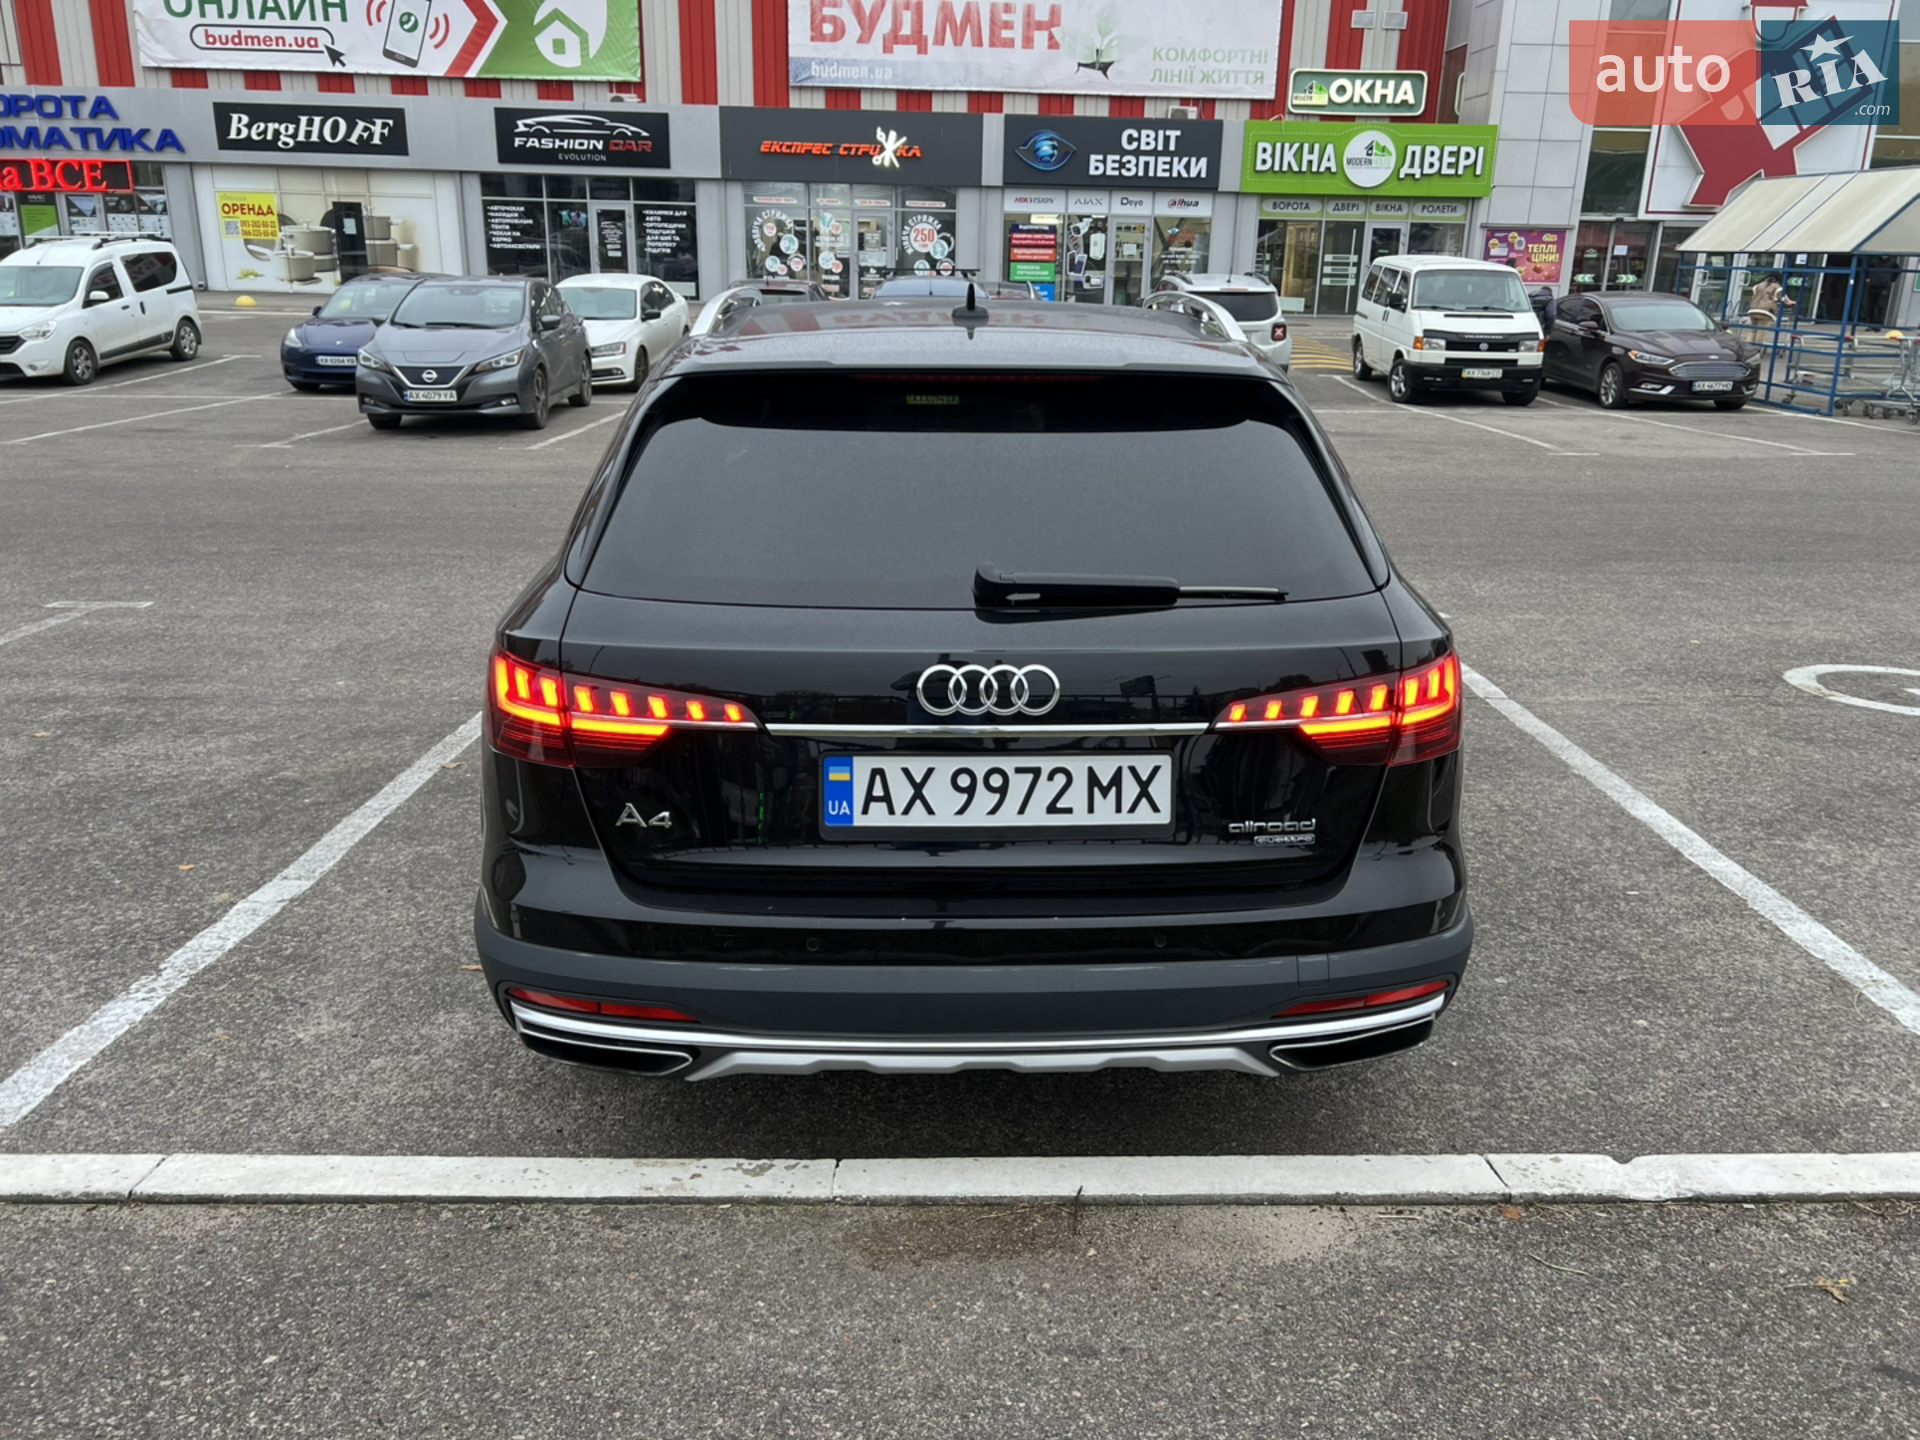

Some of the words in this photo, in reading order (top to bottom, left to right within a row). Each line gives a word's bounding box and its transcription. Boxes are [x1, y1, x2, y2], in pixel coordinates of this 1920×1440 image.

[810, 0, 1062, 55] БУДМЕН
[204, 29, 319, 49] budmen.ua
[1152, 47, 1268, 64] КОМФОРТНІ
[811, 61, 893, 80] budmen.ua
[1150, 66, 1196, 84] ЛІНІЇ
[1199, 70, 1265, 85] ЖИТТЯ
[1329, 78, 1416, 105] ОКНА
[227, 112, 394, 148] BergHOFF
[0, 126, 186, 153] МАТИКА
[513, 136, 604, 151] FASHION
[608, 140, 652, 152] CAR
[1121, 128, 1181, 151] СВІТ
[760, 141, 833, 155] ЕКСПРЕС
[558, 152, 606, 161] EVOLUTION
[1255, 141, 1338, 173] ВІКНА
[1399, 145, 1484, 179] ДВЕРІ
[1089, 154, 1208, 178] БЕЗПЕКИ
[27, 160, 108, 190] ВСЕ
[1014, 196, 1056, 204] HIKVISION
[1272, 201, 1310, 211] ВОРОТА
[1332, 202, 1360, 212] ДВЕРІ
[1375, 203, 1403, 213] ВІКНА
[221, 203, 275, 216] ОРЕНДА
[1421, 204, 1458, 214] РОЛЕТИ
[908, 214, 942, 230] СТРИЖКА
[913, 228, 935, 243] 250
[1528, 243, 1557, 253] ТЕПЛІ
[1531, 253, 1560, 263] ЦІНИ!
[861, 767, 936, 815] AX
[950, 766, 1074, 816] 9972
[1087, 765, 1162, 814] MX
[615, 802, 672, 829] A4
[828, 800, 851, 815] UA
[1228, 818, 1316, 833] allroad
